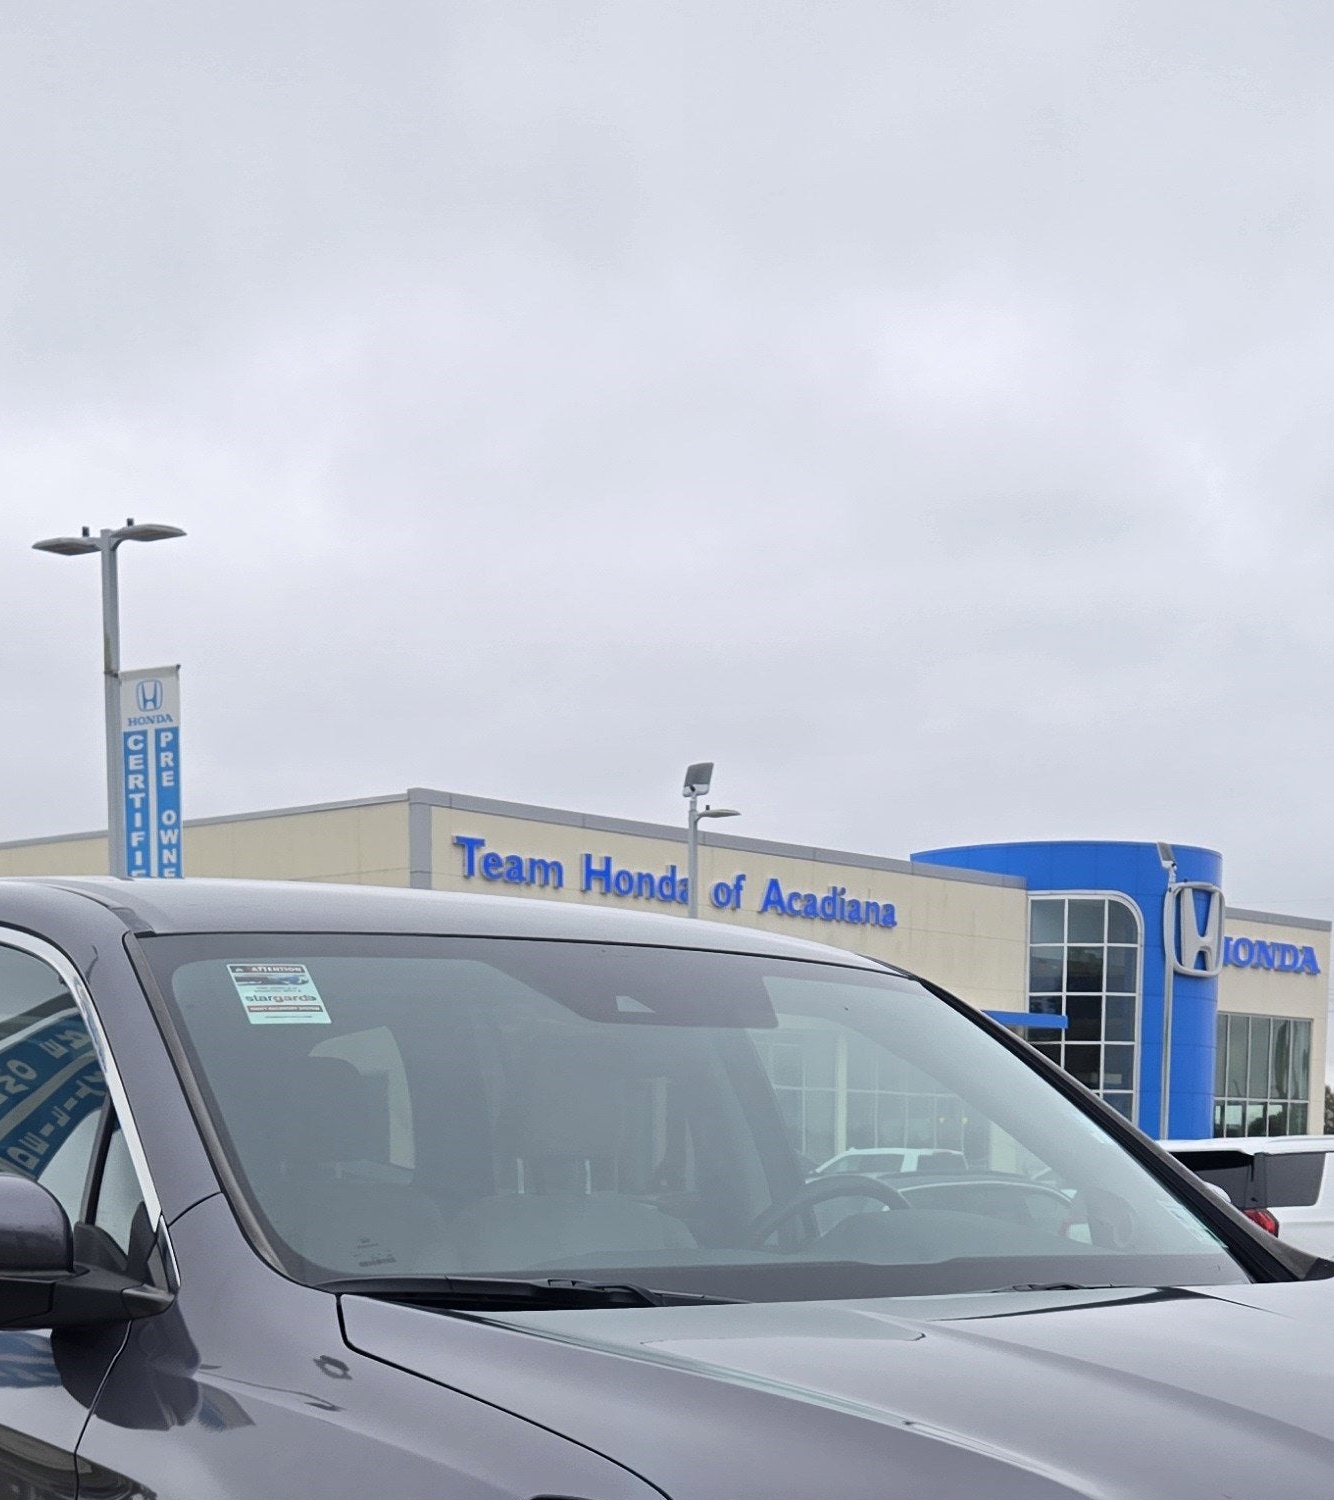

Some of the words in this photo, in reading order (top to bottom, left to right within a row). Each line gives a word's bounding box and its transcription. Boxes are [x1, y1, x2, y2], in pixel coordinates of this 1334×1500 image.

[127, 713, 174, 727] HONDA
[160, 731, 174, 787] PRE
[452, 836, 564, 889] Team
[711, 874, 747, 910] of
[758, 878, 898, 928] Acadiana
